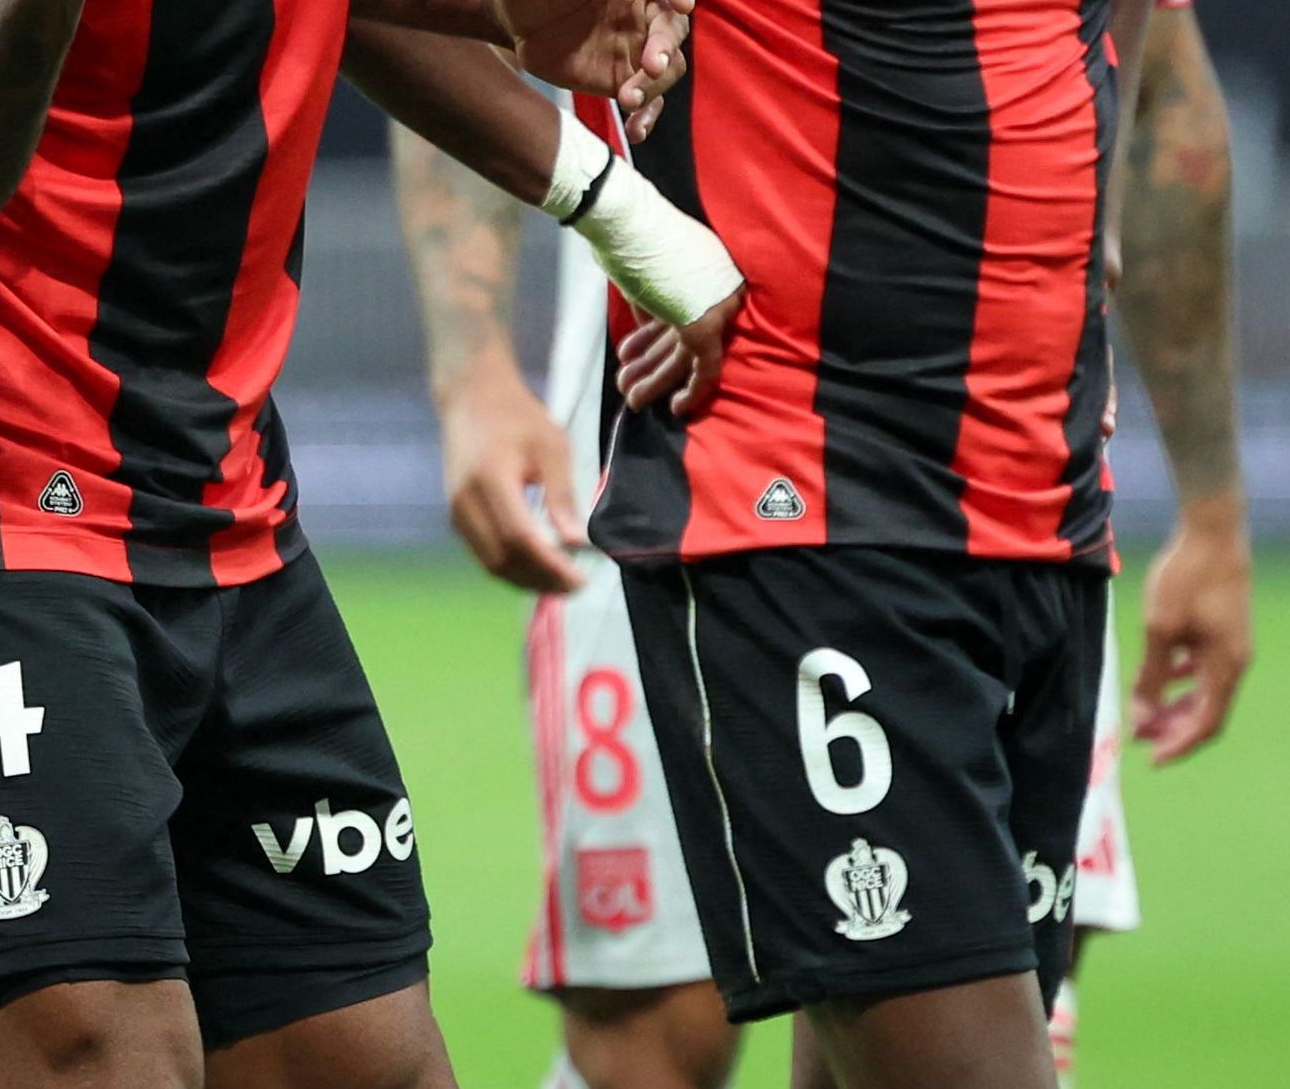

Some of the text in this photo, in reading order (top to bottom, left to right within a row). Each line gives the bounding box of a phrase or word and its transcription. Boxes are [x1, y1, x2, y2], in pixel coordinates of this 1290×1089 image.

[576, 668, 641, 812] 8
[797, 647, 893, 815] 6
[251, 797, 415, 876] vbe
